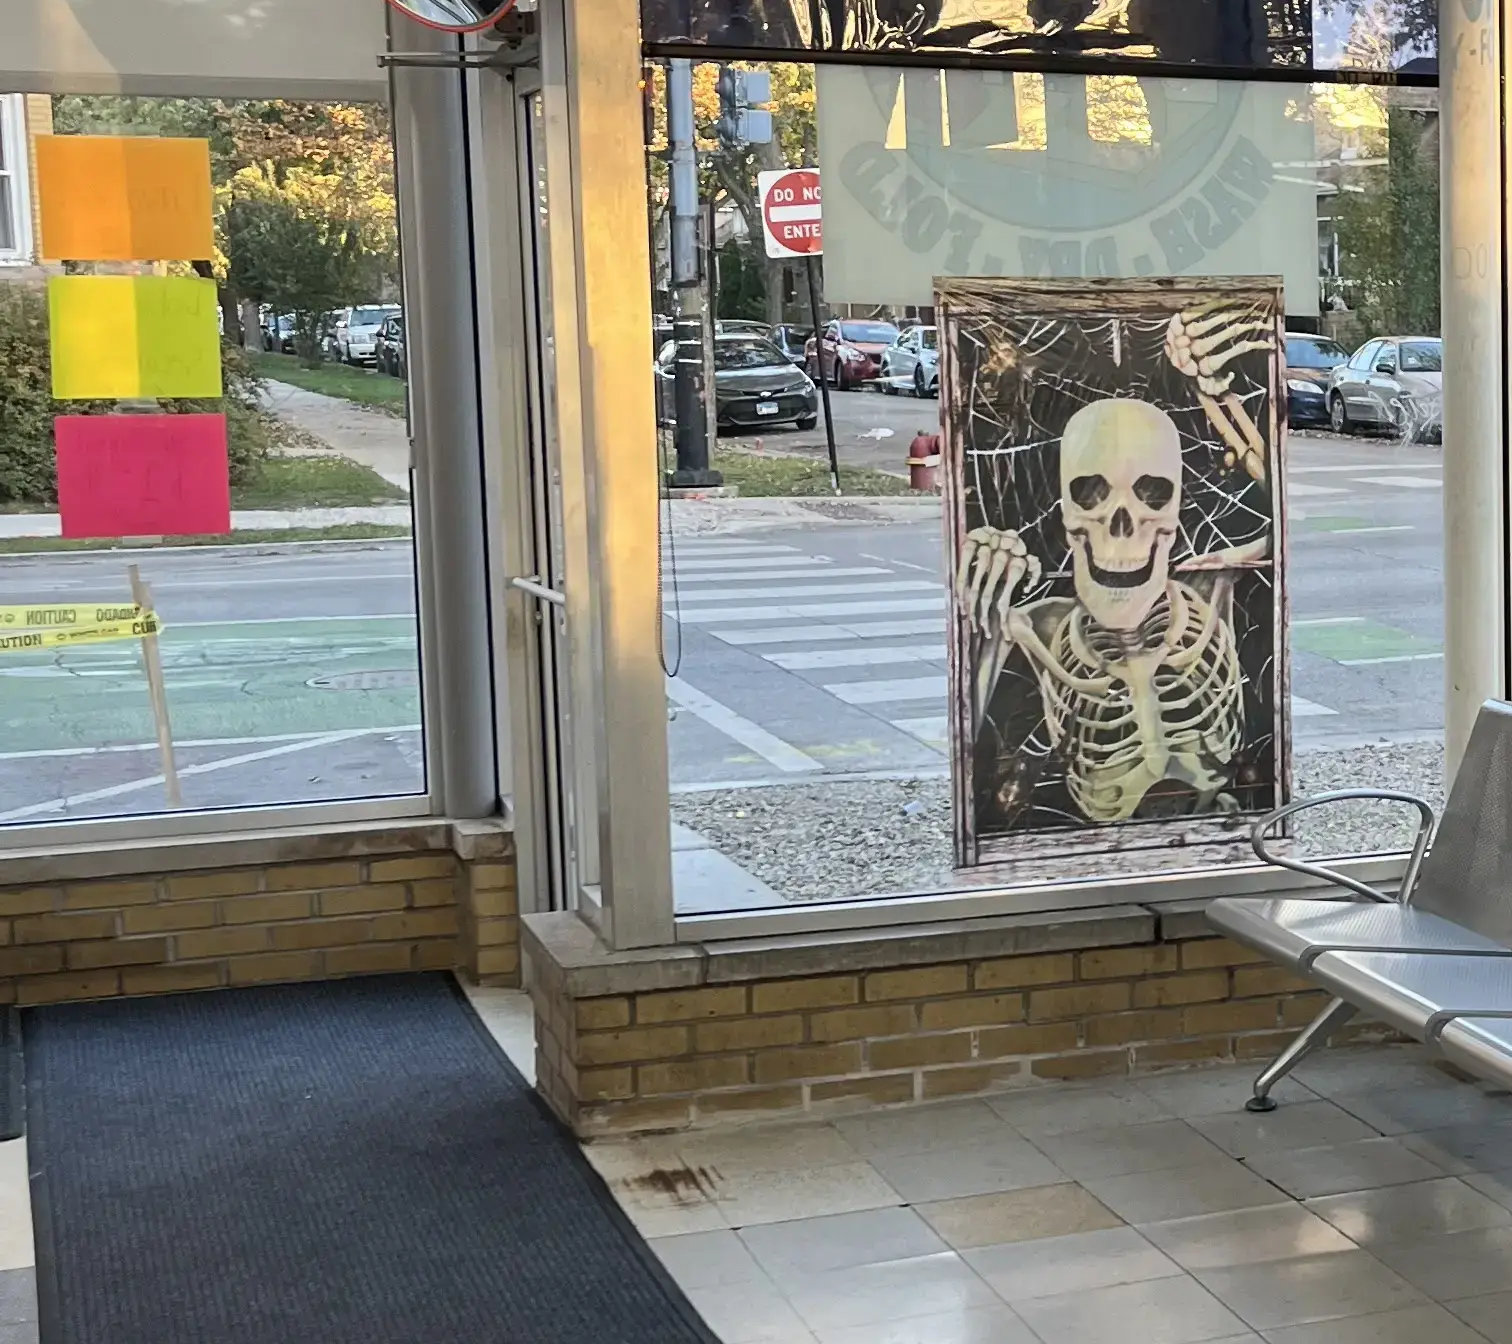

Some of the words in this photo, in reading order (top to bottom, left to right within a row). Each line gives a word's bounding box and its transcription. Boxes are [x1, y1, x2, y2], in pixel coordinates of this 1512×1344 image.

[773, 187, 794, 203] DO
[802, 186, 822, 201] NO
[783, 223, 822, 240] ENTE
[0, 633, 42, 649] UTION
